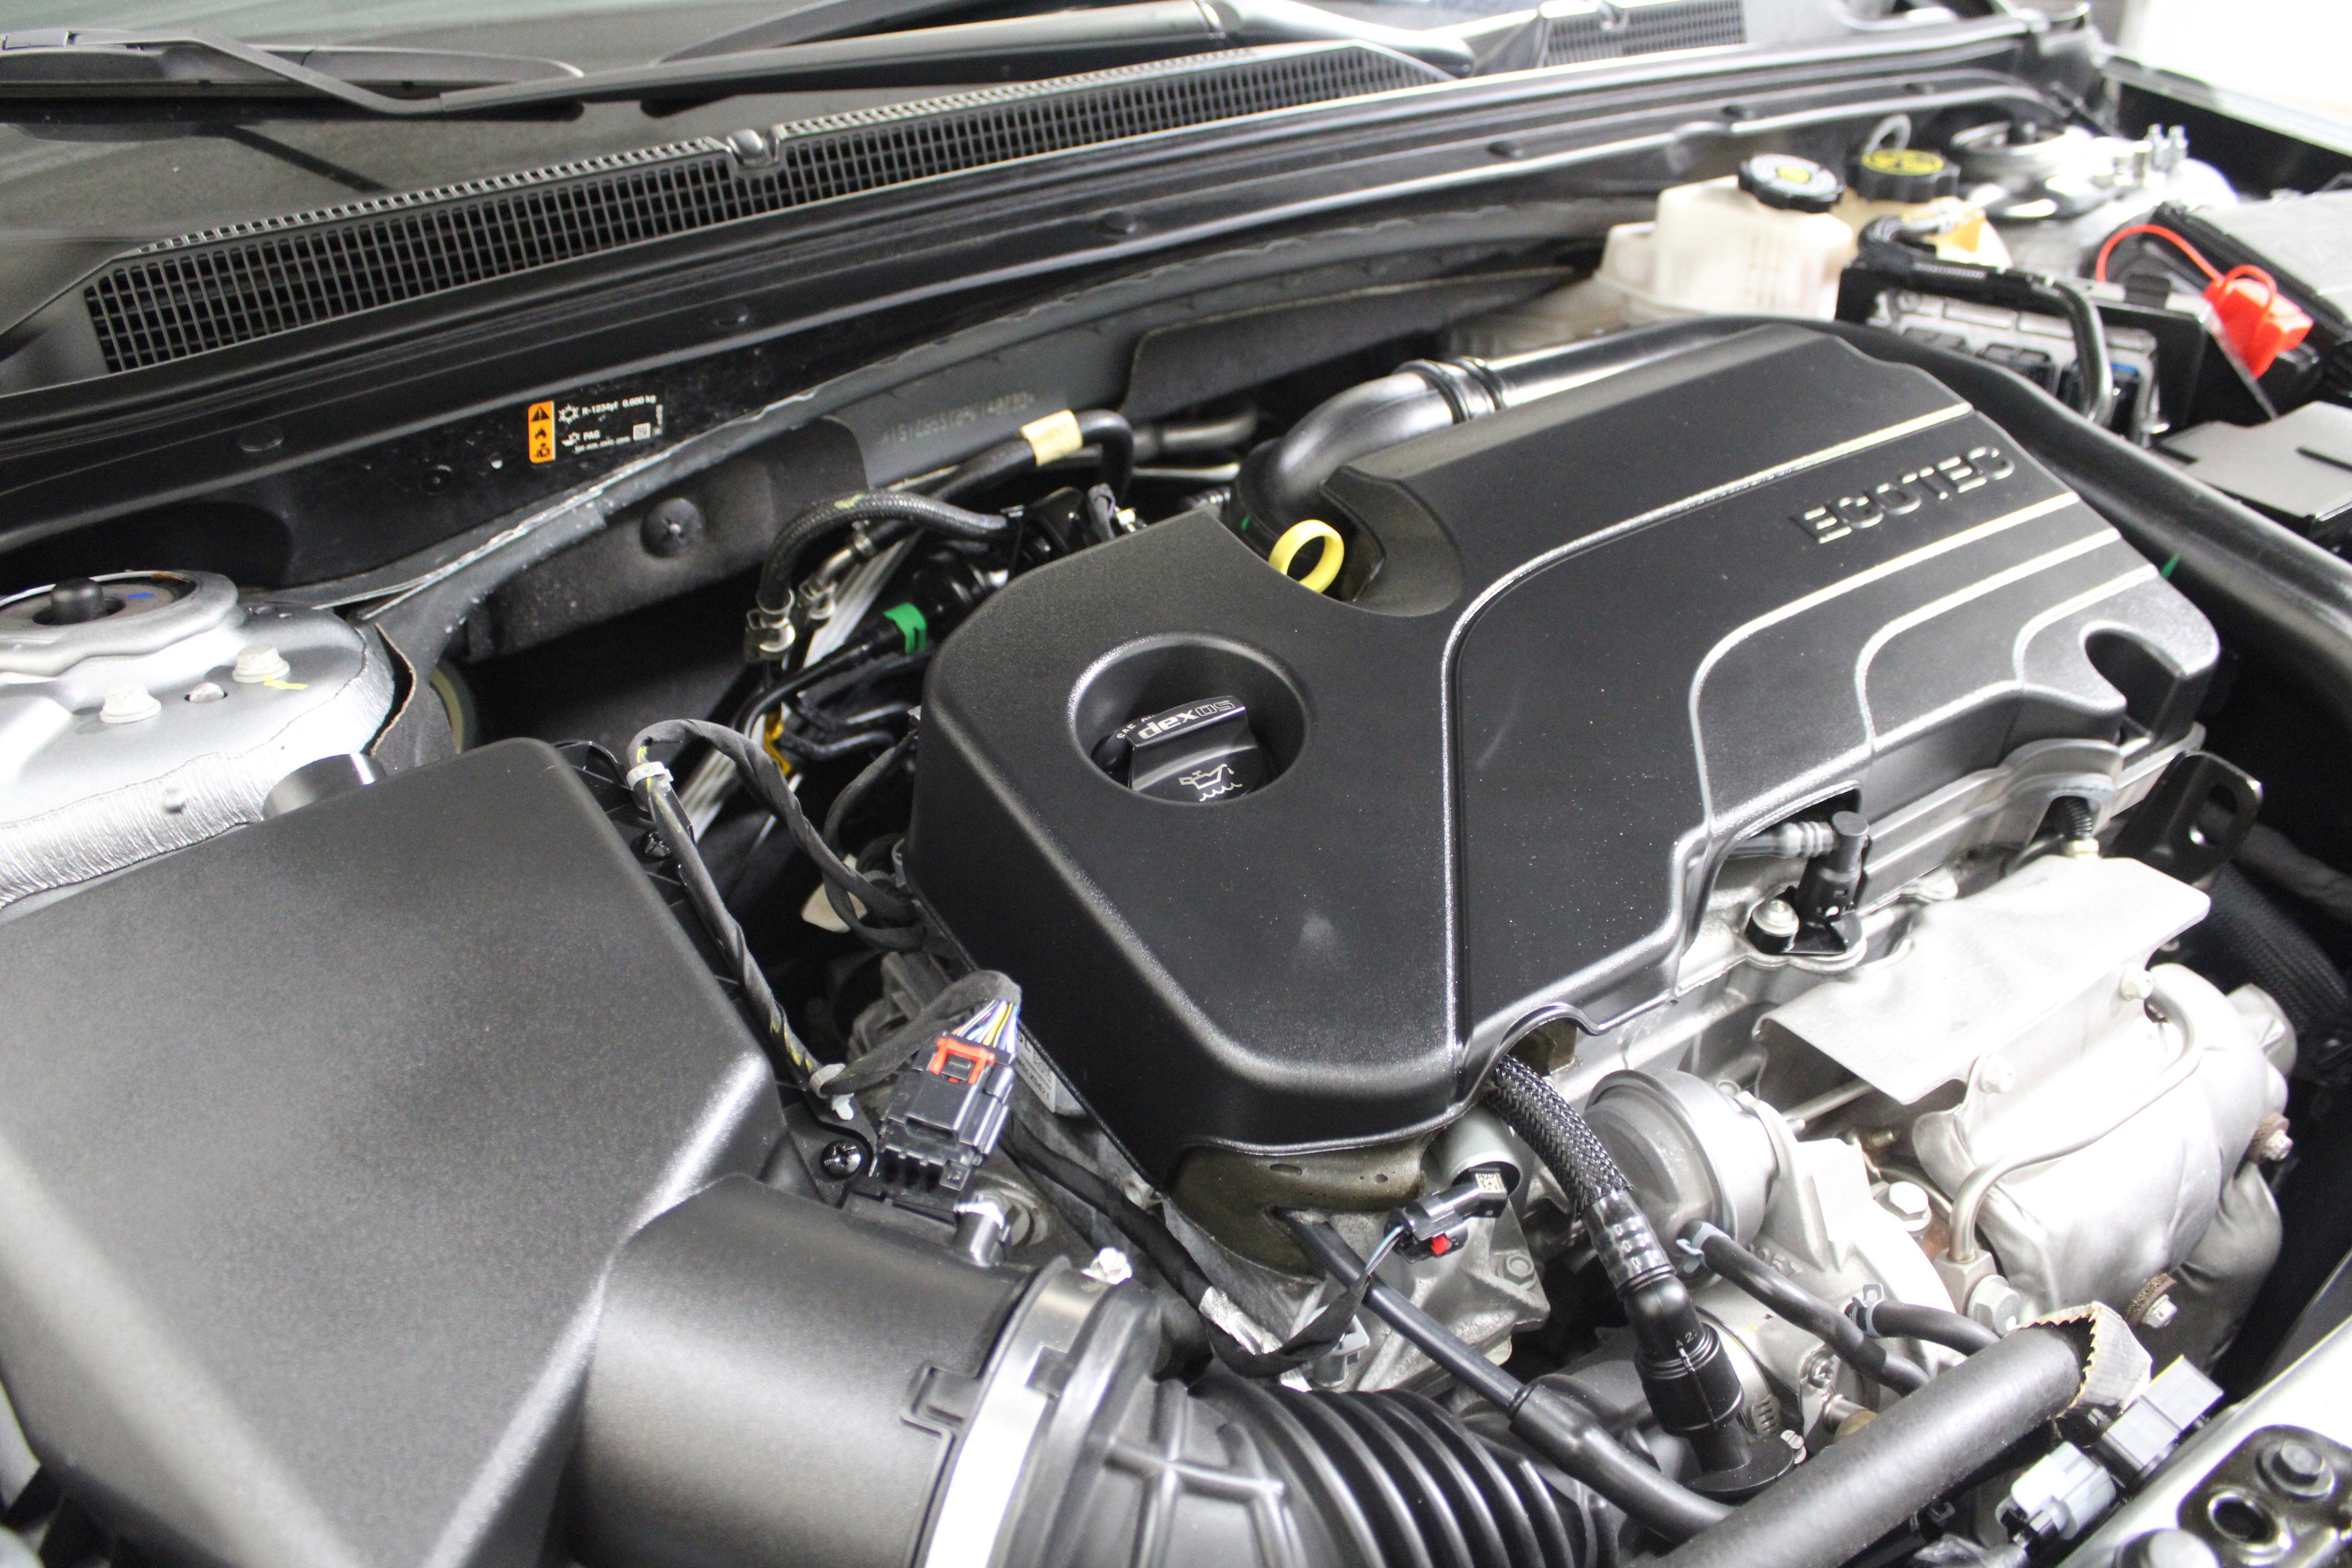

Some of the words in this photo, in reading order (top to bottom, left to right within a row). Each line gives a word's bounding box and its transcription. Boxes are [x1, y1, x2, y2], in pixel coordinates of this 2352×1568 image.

[581, 401, 619, 416] R-1234yf
[645, 394, 657, 405] kg
[1790, 446, 2015, 544] ECOTEC
